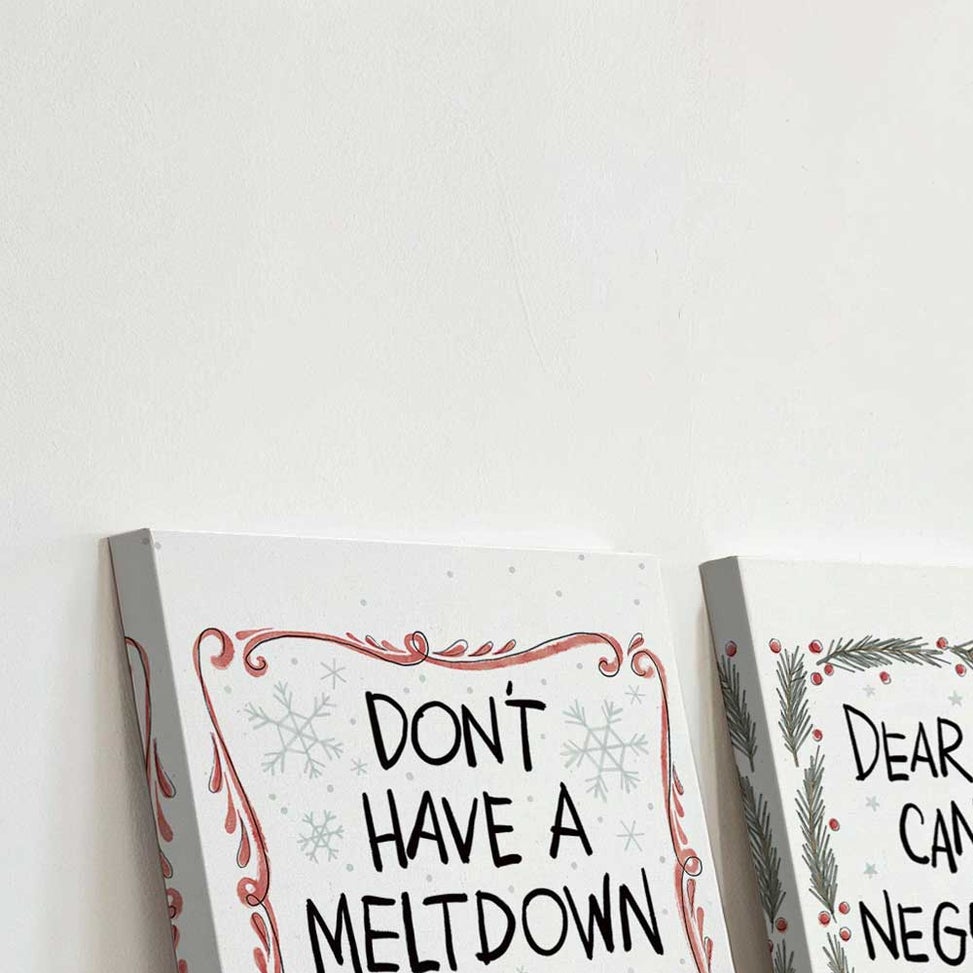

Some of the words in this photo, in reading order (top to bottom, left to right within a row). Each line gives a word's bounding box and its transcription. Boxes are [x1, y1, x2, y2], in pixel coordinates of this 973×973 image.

[366, 681, 546, 772] DON'T
[843, 704, 973, 783] DEAR
[362, 789, 522, 872] HAVE
[550, 782, 593, 859] A
